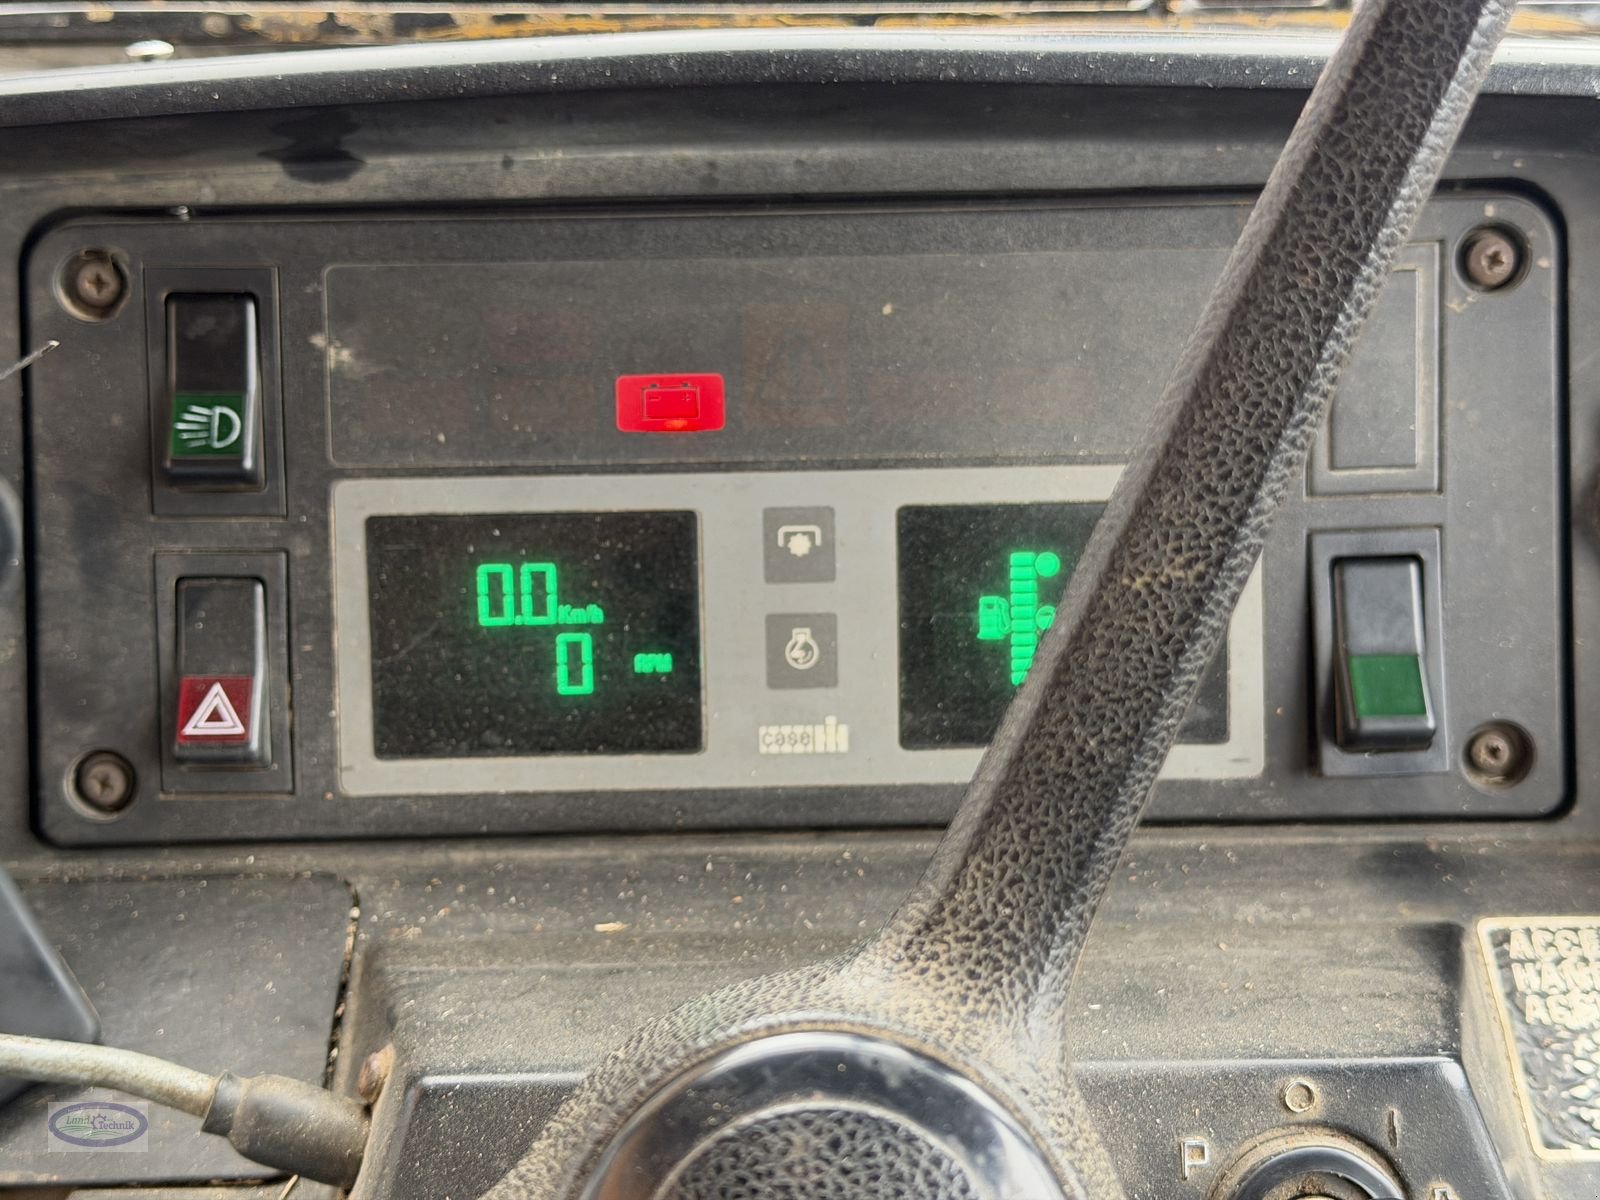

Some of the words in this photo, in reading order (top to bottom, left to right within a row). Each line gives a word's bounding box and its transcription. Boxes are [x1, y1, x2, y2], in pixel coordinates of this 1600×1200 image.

[477, 563, 558, 626] 0.0
[556, 632, 594, 695] 0
[1181, 1138, 1209, 1180] P
